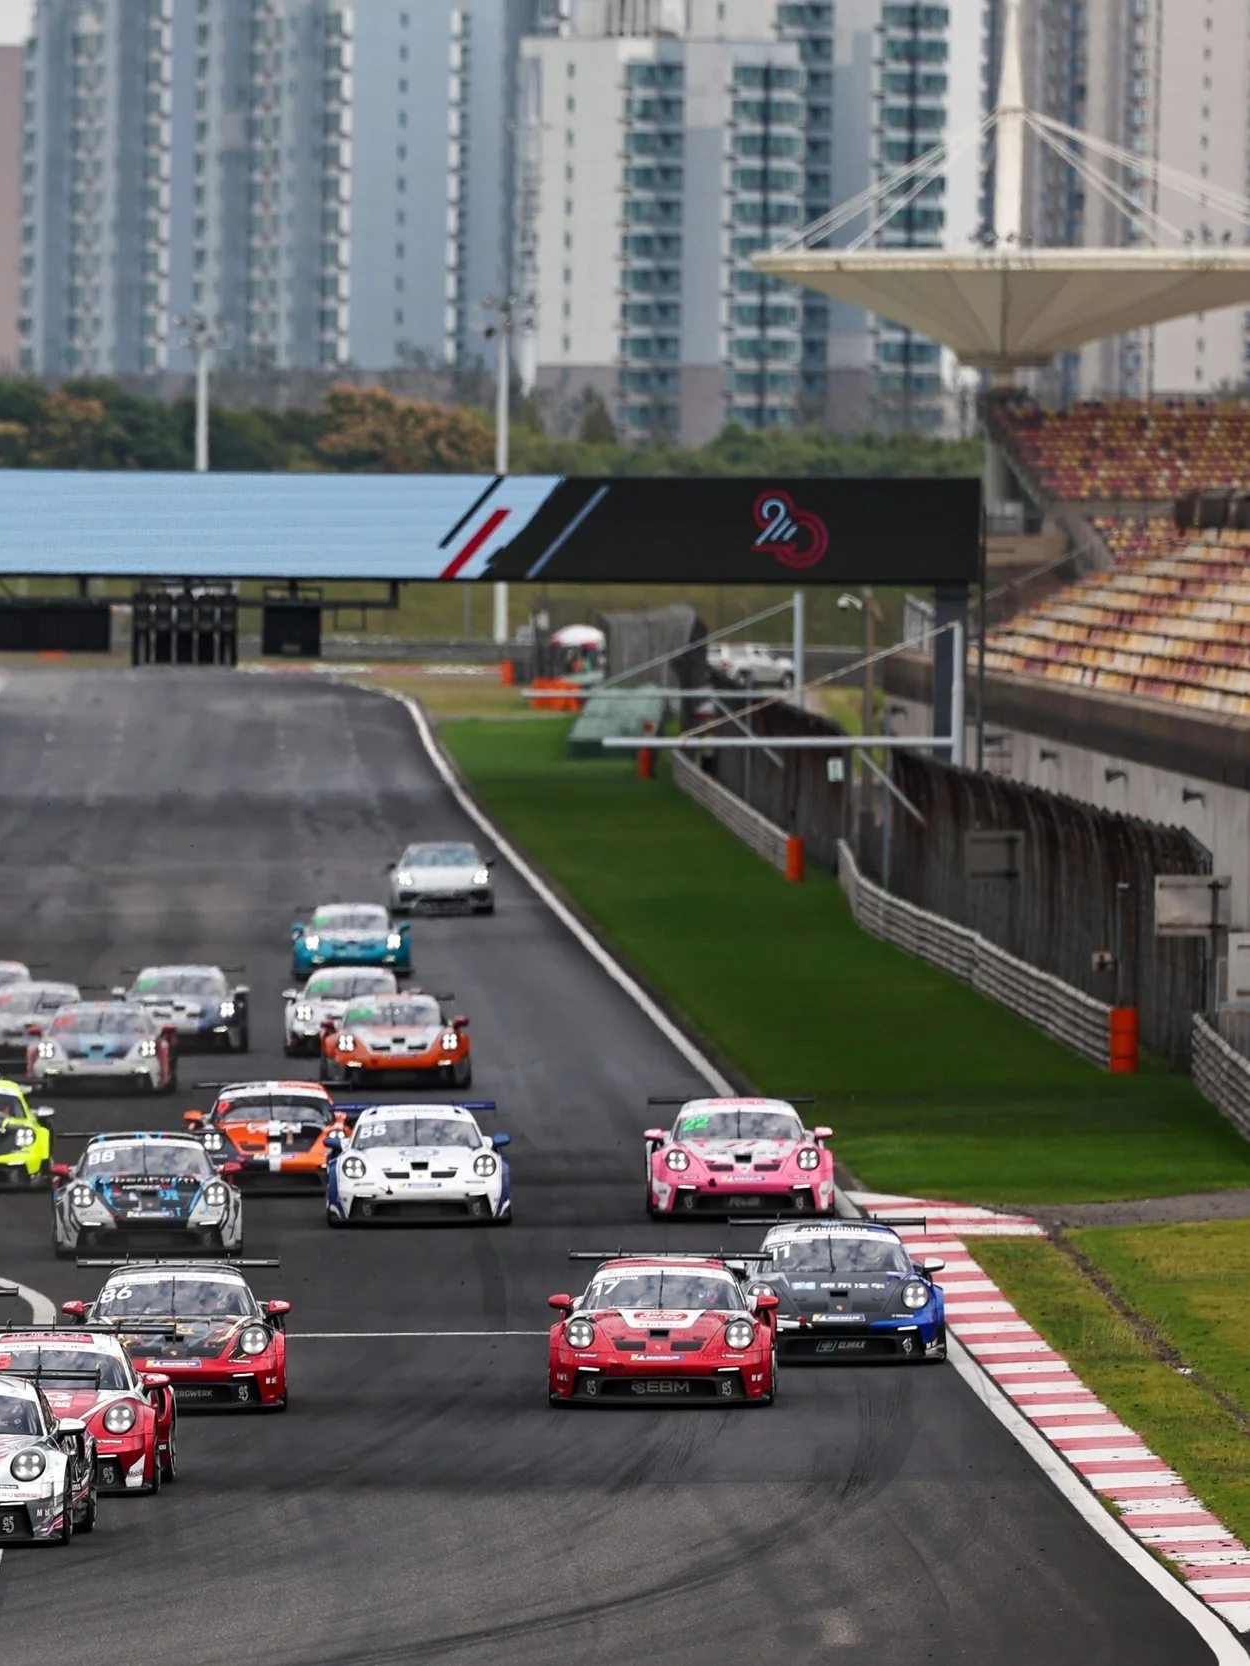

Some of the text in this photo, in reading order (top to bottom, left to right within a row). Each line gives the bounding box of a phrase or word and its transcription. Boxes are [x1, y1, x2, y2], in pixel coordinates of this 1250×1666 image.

[100, 1286, 133, 1304] 86
[592, 1280, 621, 1297] 17
[646, 1380, 690, 1393] EBM
